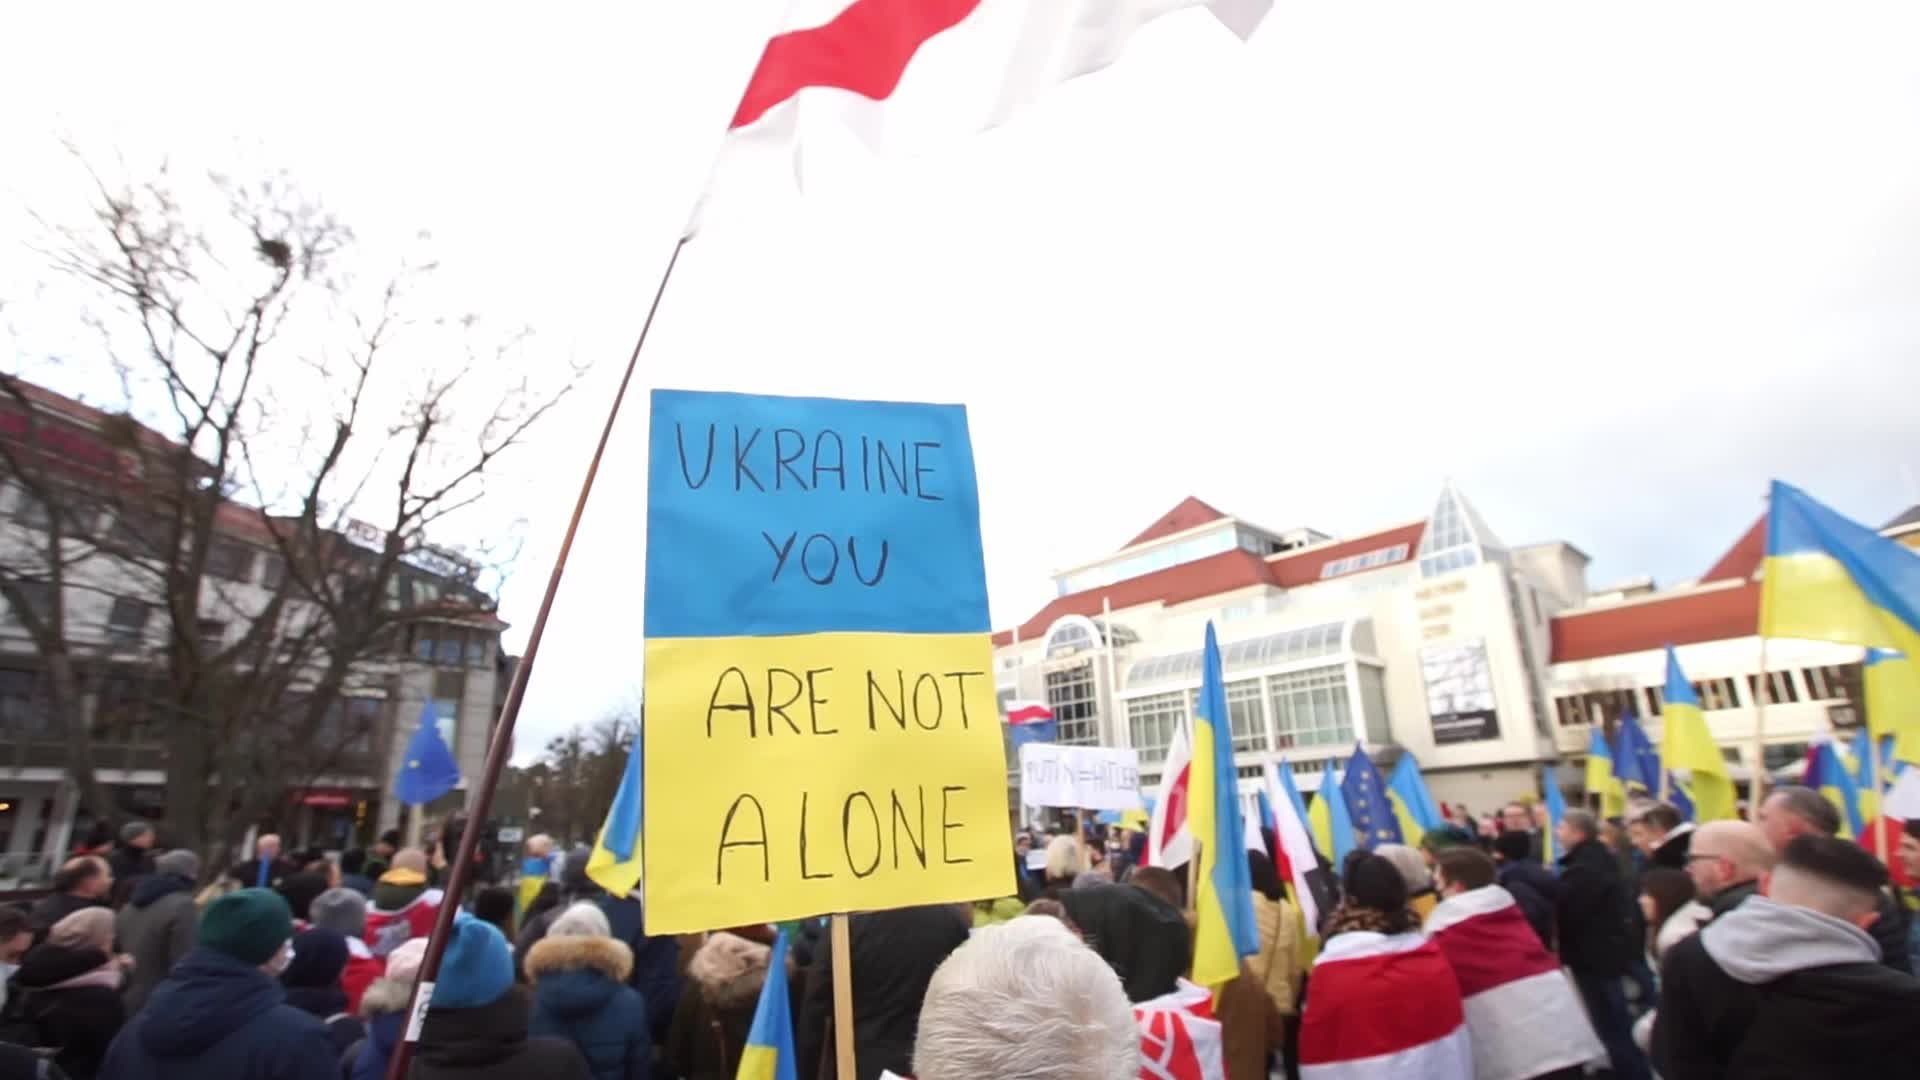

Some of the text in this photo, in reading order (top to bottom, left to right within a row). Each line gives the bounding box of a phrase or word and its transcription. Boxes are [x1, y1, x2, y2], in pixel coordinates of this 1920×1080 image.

[676, 423, 944, 501] UKRAINE
[762, 531, 889, 587] YOU
[706, 666, 985, 739] ARE NOT
[716, 785, 973, 886] ALONE
